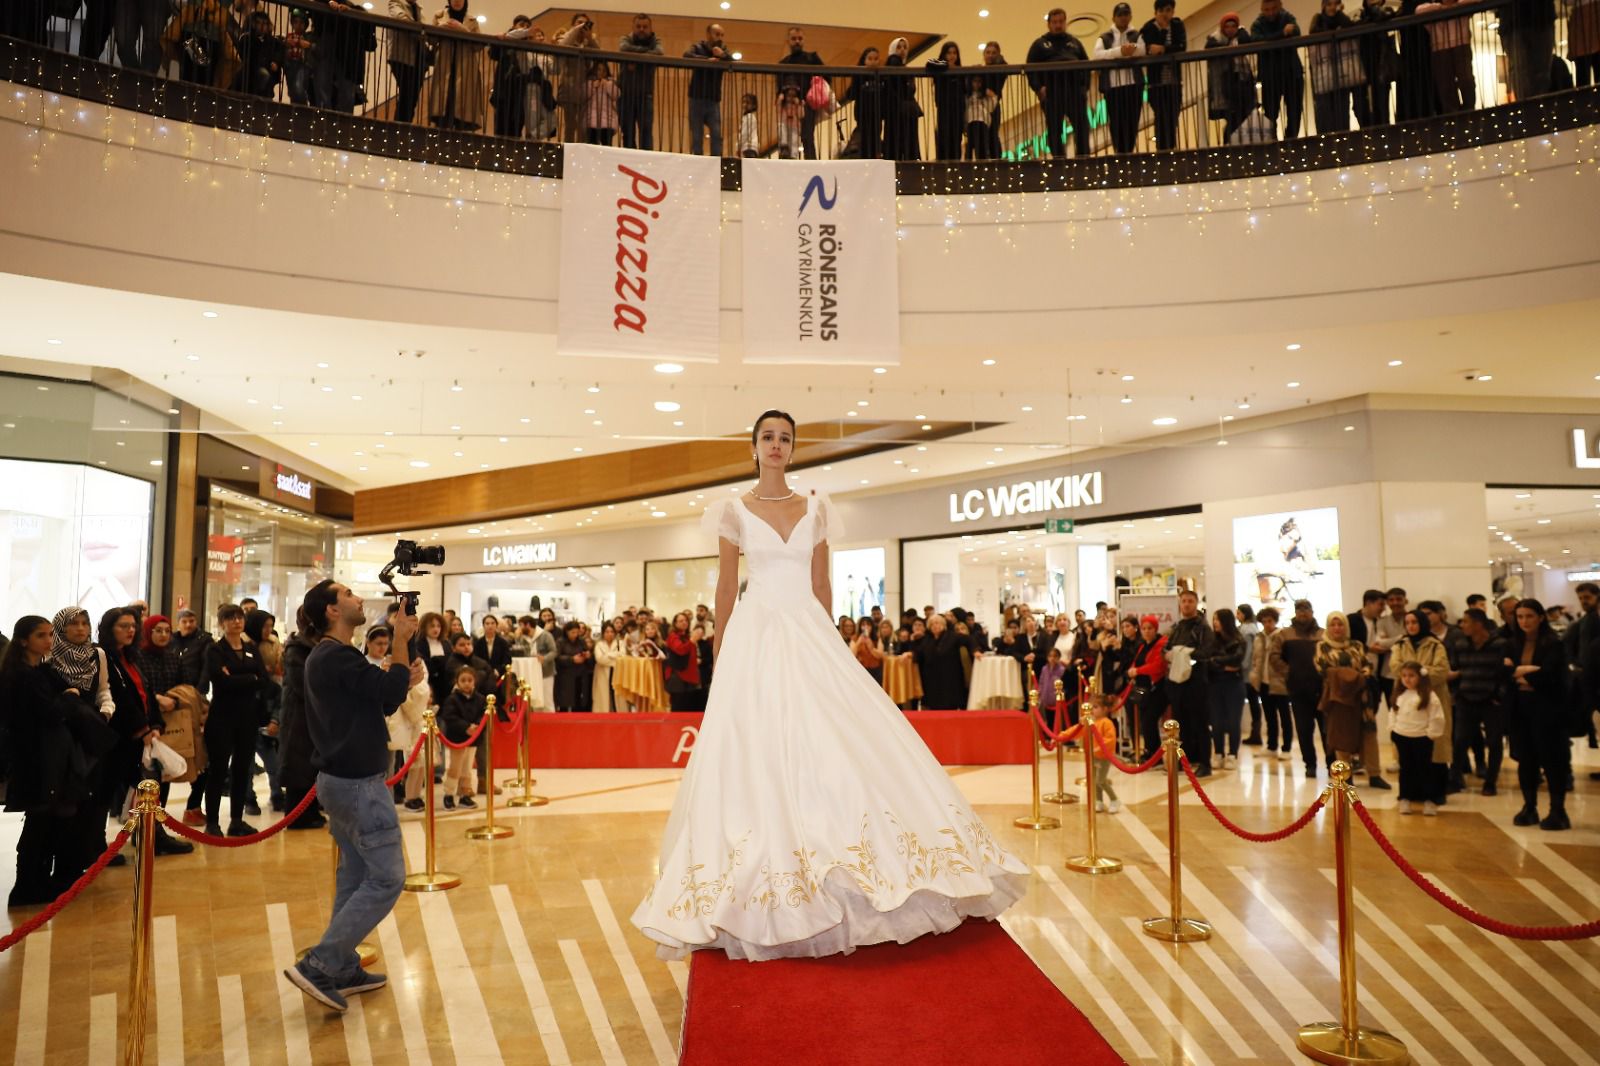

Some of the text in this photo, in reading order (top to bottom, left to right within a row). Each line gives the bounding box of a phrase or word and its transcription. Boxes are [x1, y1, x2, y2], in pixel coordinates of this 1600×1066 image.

[614, 164, 668, 334] Piazza
[798, 223, 816, 342] GAYRİMENKUL
[819, 223, 843, 342] RÖNESANS
[1573, 428, 1600, 469] L
[950, 489, 985, 522] LC
[483, 545, 502, 567] LC
